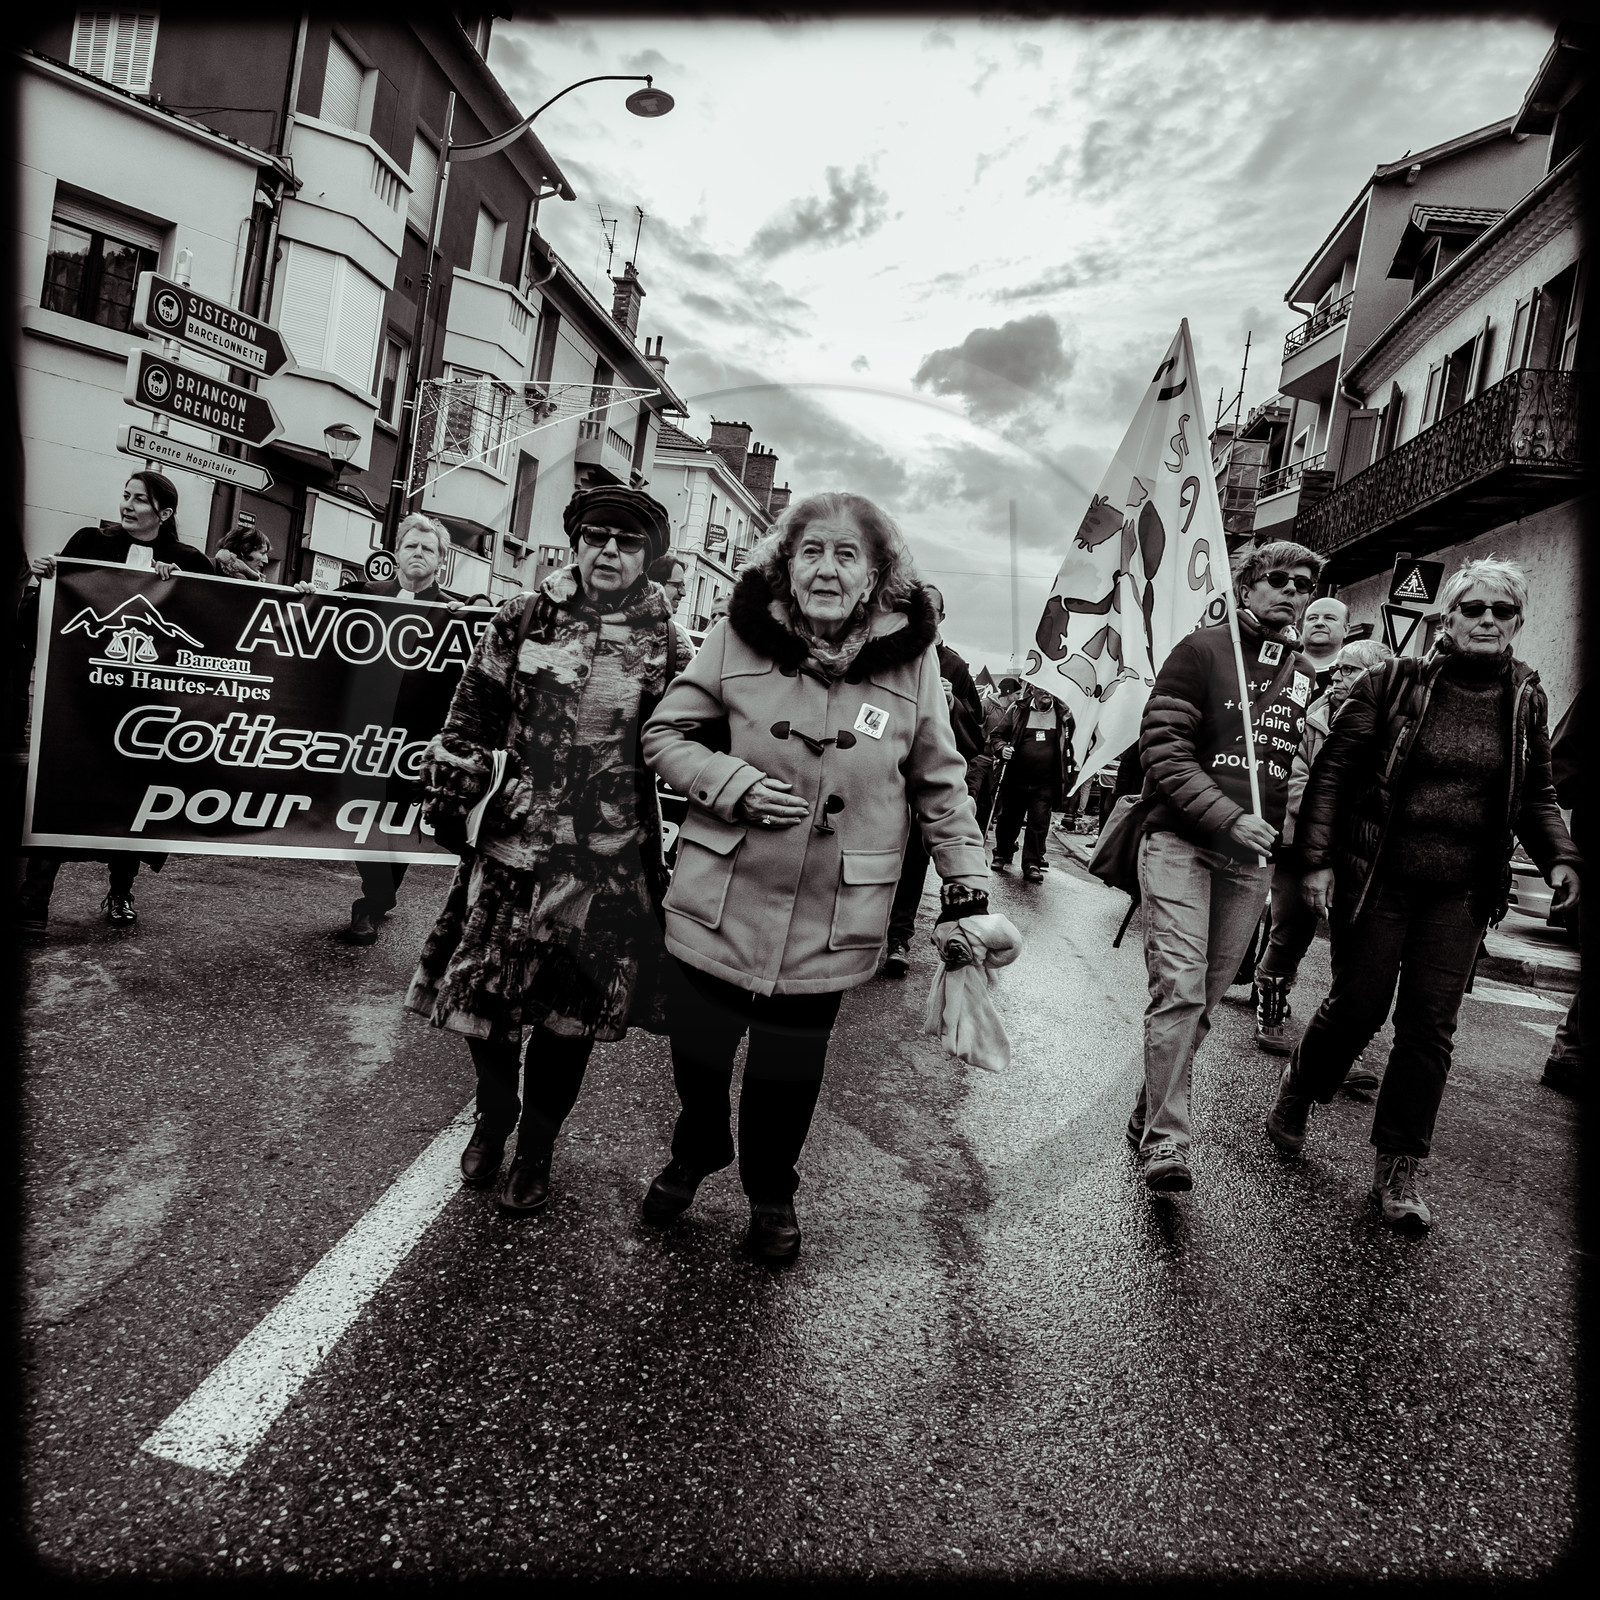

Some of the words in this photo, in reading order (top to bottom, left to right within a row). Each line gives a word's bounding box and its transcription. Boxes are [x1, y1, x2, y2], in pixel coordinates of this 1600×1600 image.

[161, 309, 173, 320] 19t
[188, 297, 257, 342] SISTERON
[188, 322, 265, 365] BARCELONNETTE
[150, 383, 162, 395] 19t
[176, 373, 247, 413] BRIANCON
[173, 395, 246, 433] GRENOBLE
[149, 440, 181, 459] Centre
[186, 451, 237, 477] Hospitalier
[315, 569, 324, 578] AUX
[316, 556, 340, 571] FORMATION
[371, 560, 392, 577] 30
[176, 649, 251, 674] Barreau
[89, 667, 125, 687] des
[130, 671, 271, 703] Hautes-Alpes
[130, 784, 312, 832] pour
